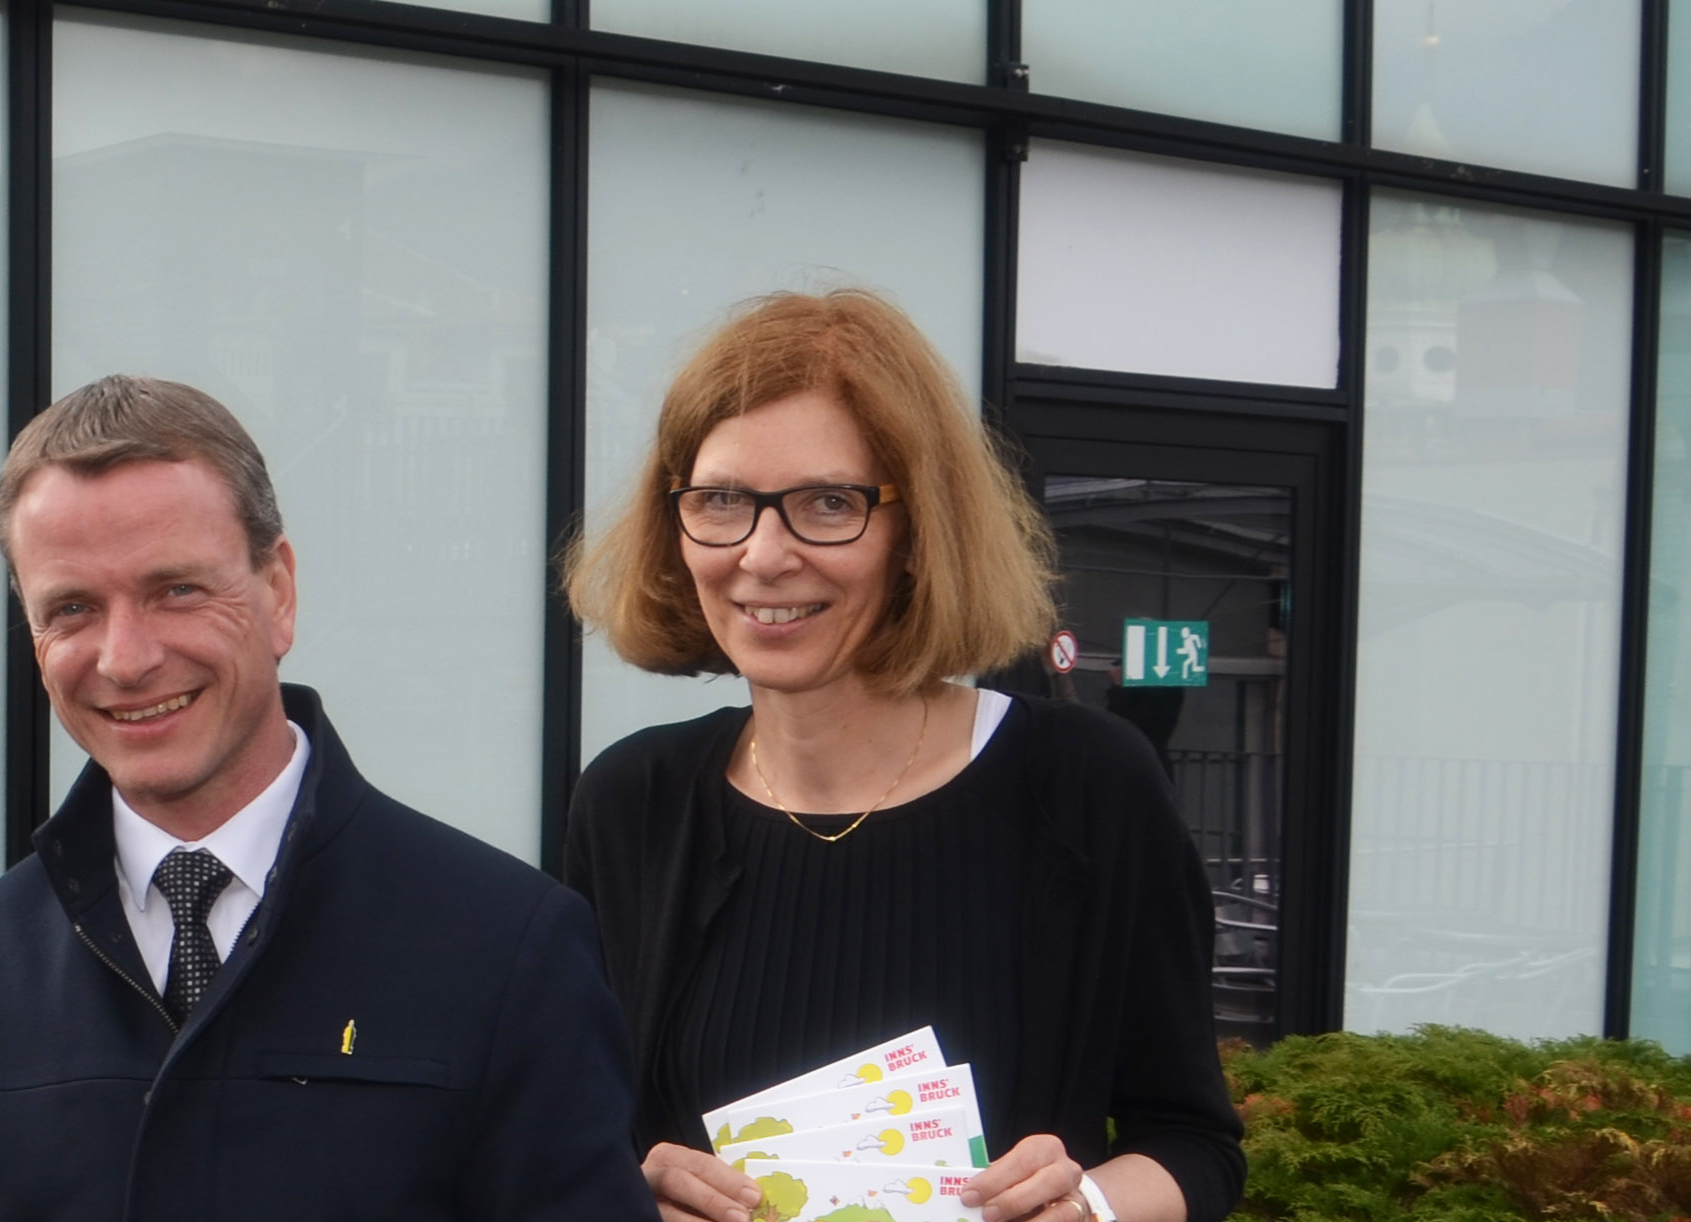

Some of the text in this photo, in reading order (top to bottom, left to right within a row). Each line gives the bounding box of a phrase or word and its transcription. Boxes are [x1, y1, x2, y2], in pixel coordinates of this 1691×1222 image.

[888, 1050, 927, 1072] BRUCK
[920, 1087, 961, 1102] BRUCK
[911, 1128, 952, 1141] BRUCK
